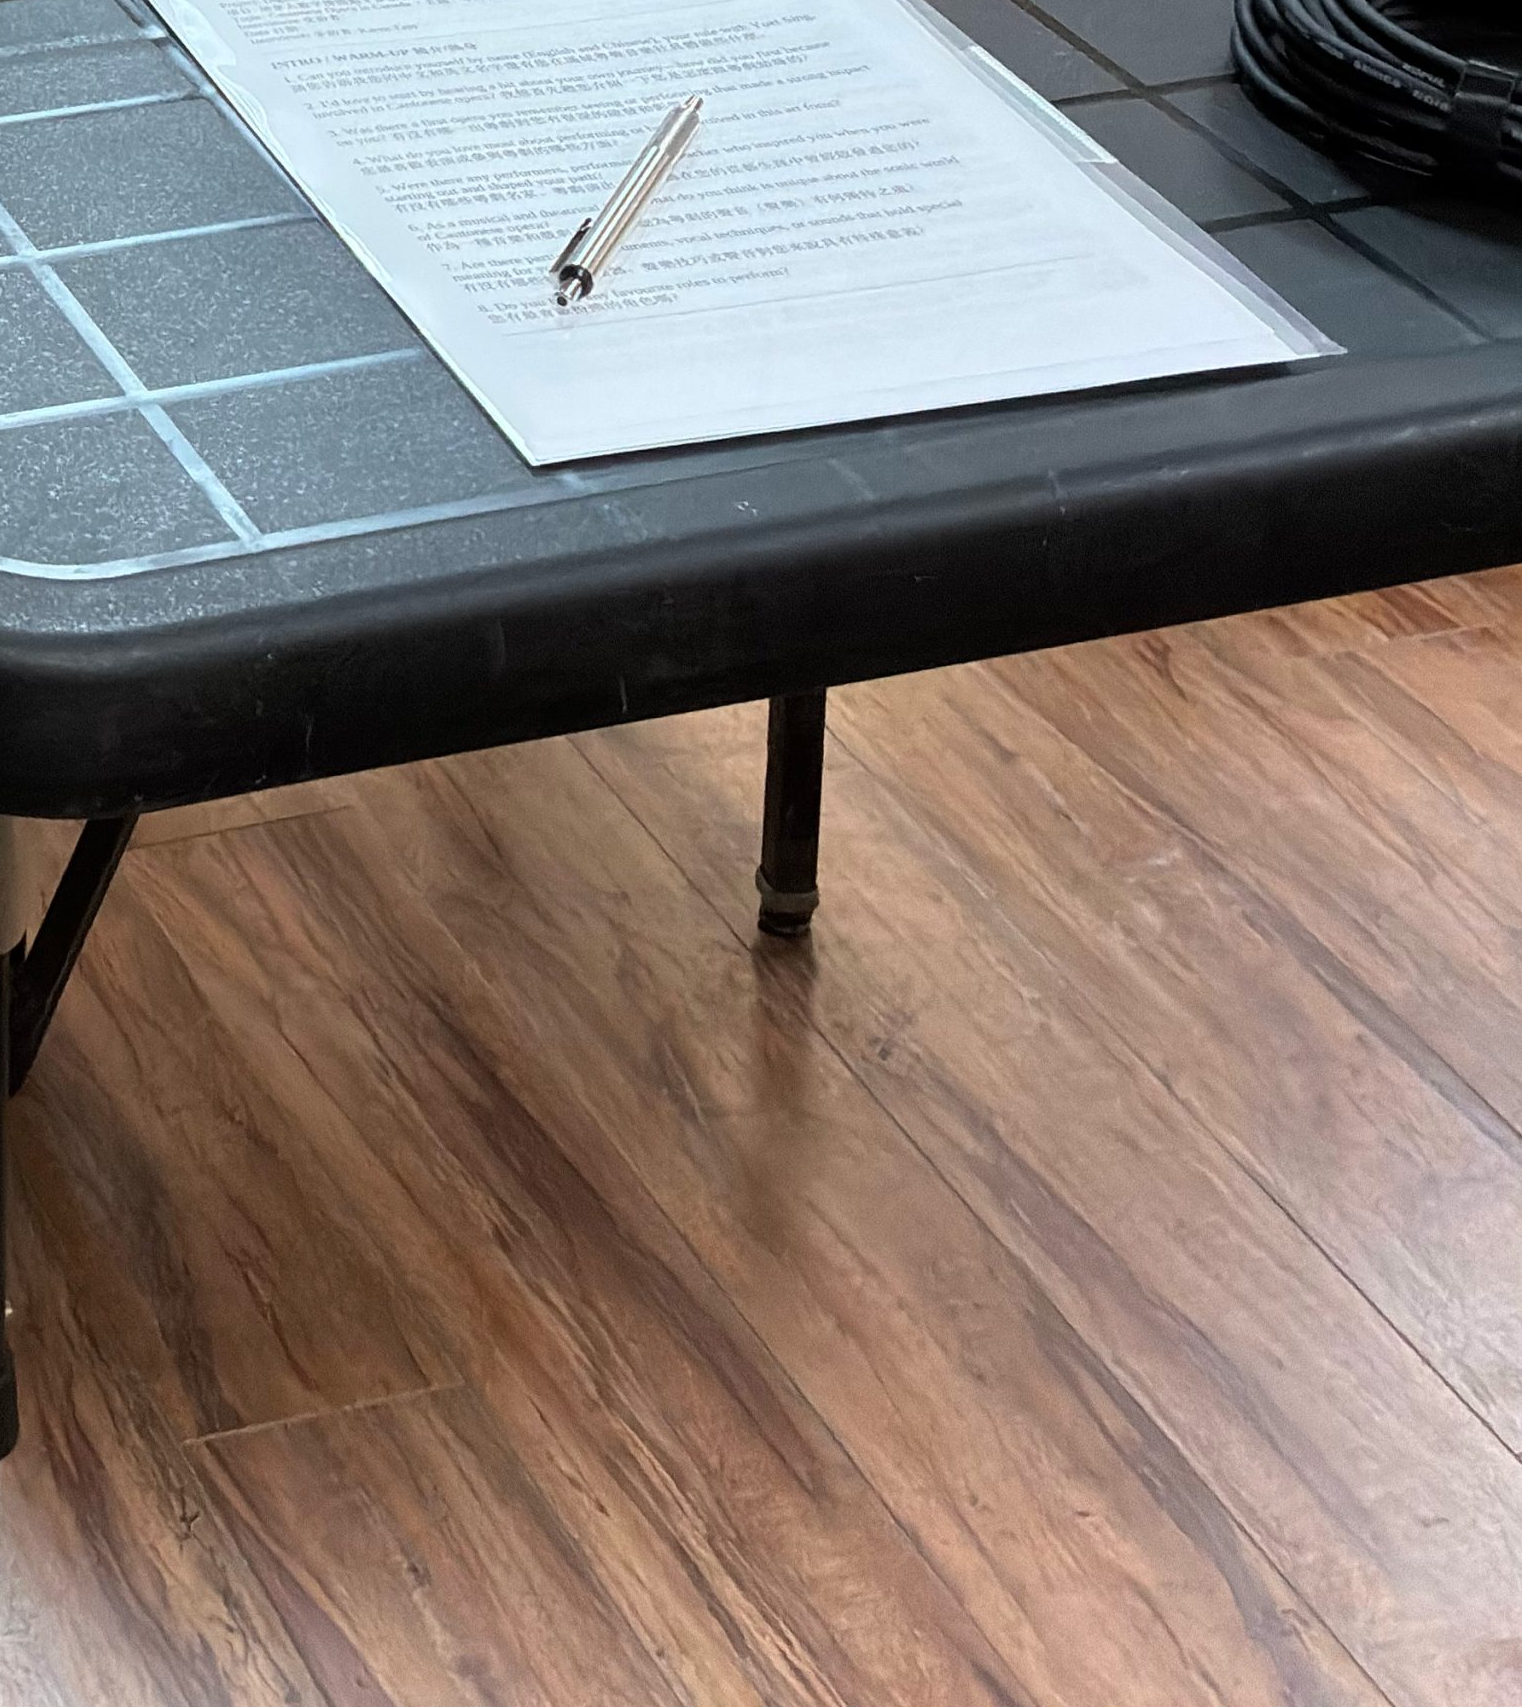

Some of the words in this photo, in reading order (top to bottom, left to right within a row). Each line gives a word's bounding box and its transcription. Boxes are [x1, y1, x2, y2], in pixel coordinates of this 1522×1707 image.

[696, 113, 741, 124] volved
[682, 148, 719, 158] acher
[645, 195, 676, 204] hat
[620, 240, 674, 251] uments,
